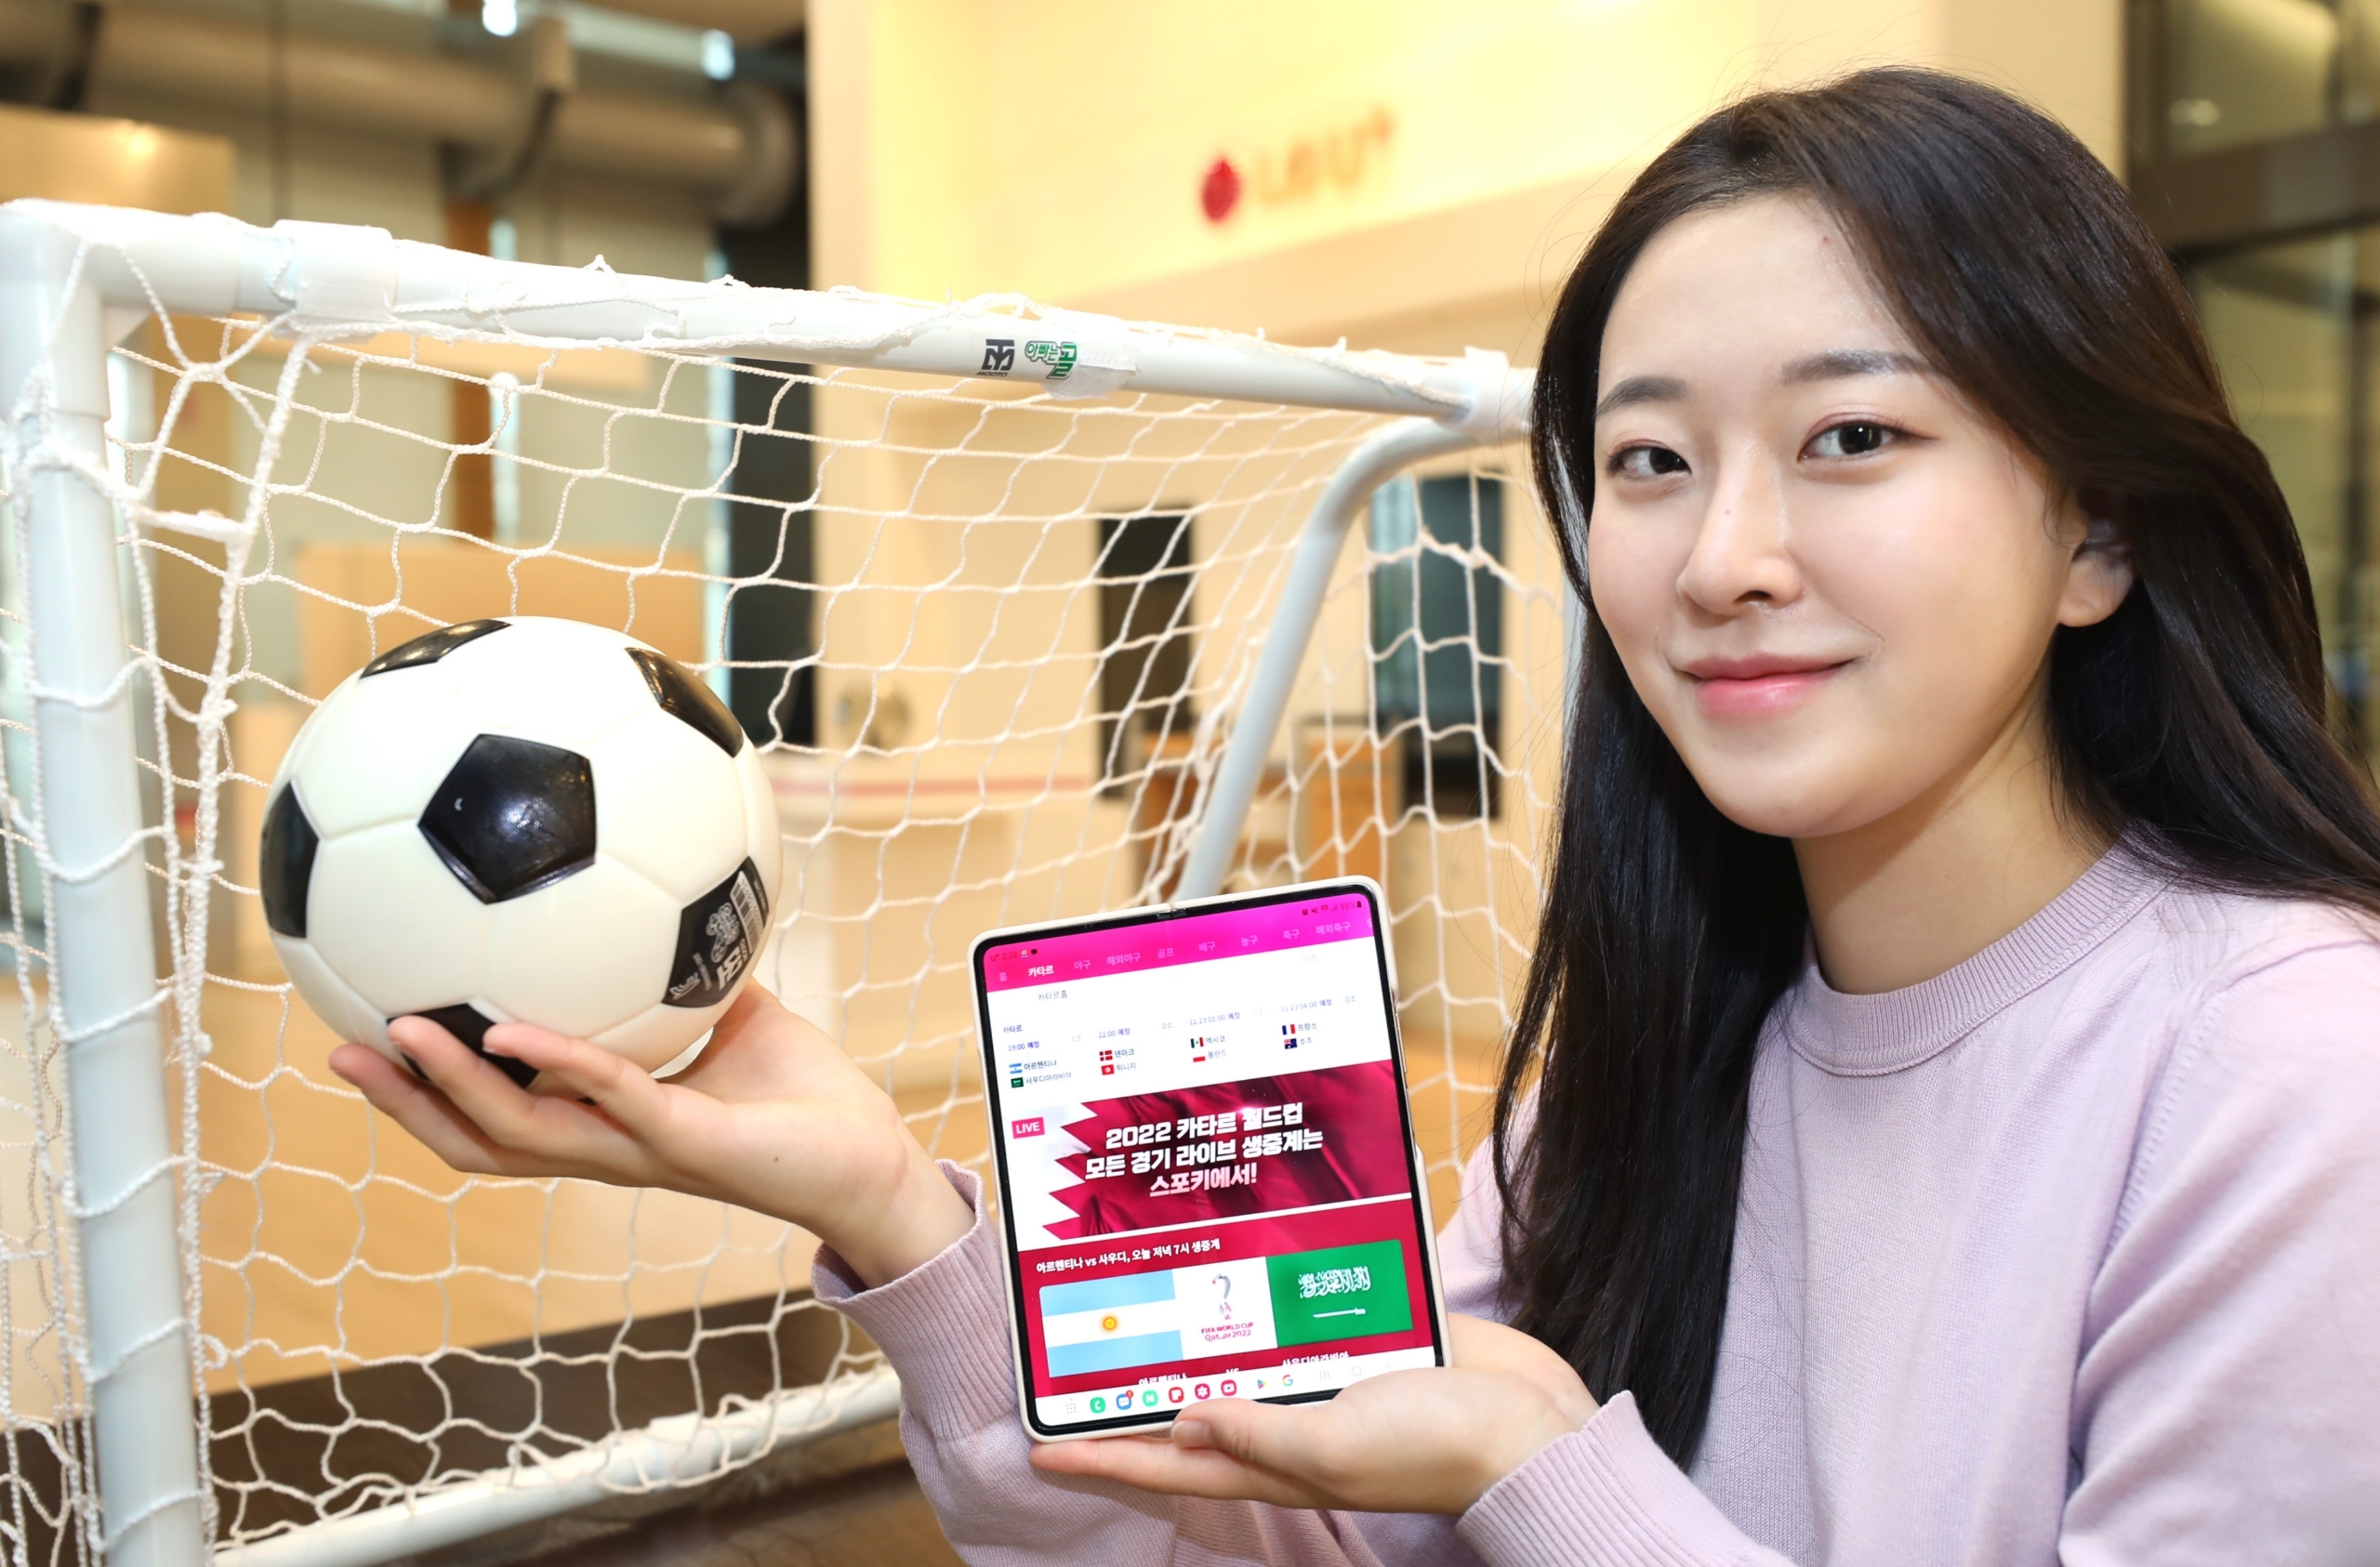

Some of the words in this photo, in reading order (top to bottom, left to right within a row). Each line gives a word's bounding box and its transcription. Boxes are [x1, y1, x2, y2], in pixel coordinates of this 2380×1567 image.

[1027, 965, 1054, 978] 카타르
[1074, 959, 1091, 971] 야구
[1106, 952, 1142, 967] 해외야구
[1157, 947, 1175, 960] 골프
[1198, 942, 1216, 953] 배구
[1240, 934, 1259, 947] 농구
[1282, 928, 1301, 941] 축구
[1316, 921, 1352, 936] 해외축구
[1319, 998, 1332, 1007] 예정
[1227, 1011, 1240, 1021] 예정
[1002, 1024, 1023, 1034] 카타르
[1098, 1030, 1116, 1039] 22:00
[1117, 1027, 1130, 1036] 예정
[1298, 1021, 1318, 1033] 프랑스
[1008, 1042, 1025, 1052] 19:00
[1026, 1040, 1040, 1049] 예정
[1205, 1034, 1225, 1046] 멕시코
[1300, 1035, 1313, 1047] 호주
[1114, 1048, 1135, 1058] 덴마크
[1024, 1059, 1057, 1071] 아르헨티나
[1025, 1072, 1072, 1086] 사우디아라비아
[1015, 1122, 1040, 1135] LIVE
[1105, 1121, 1171, 1150] 2022
[1176, 1112, 1237, 1140] 카타르
[1242, 1101, 1303, 1132] 월드컵
[1085, 1153, 1126, 1180] 모든
[1130, 1148, 1170, 1175] 경기
[1176, 1139, 1236, 1167] 라이브
[1241, 1128, 1324, 1159] 생중계는
[1149, 1162, 1258, 1198] 스포키에서!
[1036, 1258, 1083, 1274] 아르헨티나
[1085, 1258, 1097, 1267] vs
[1098, 1251, 1130, 1265] 사우디,
[1131, 1248, 1151, 1260] 오늘
[1153, 1244, 1171, 1258] 저녁
[1173, 1242, 1190, 1255] 7시
[1191, 1238, 1221, 1254] 생중계
[1216, 1323, 1240, 1332] WORLD
